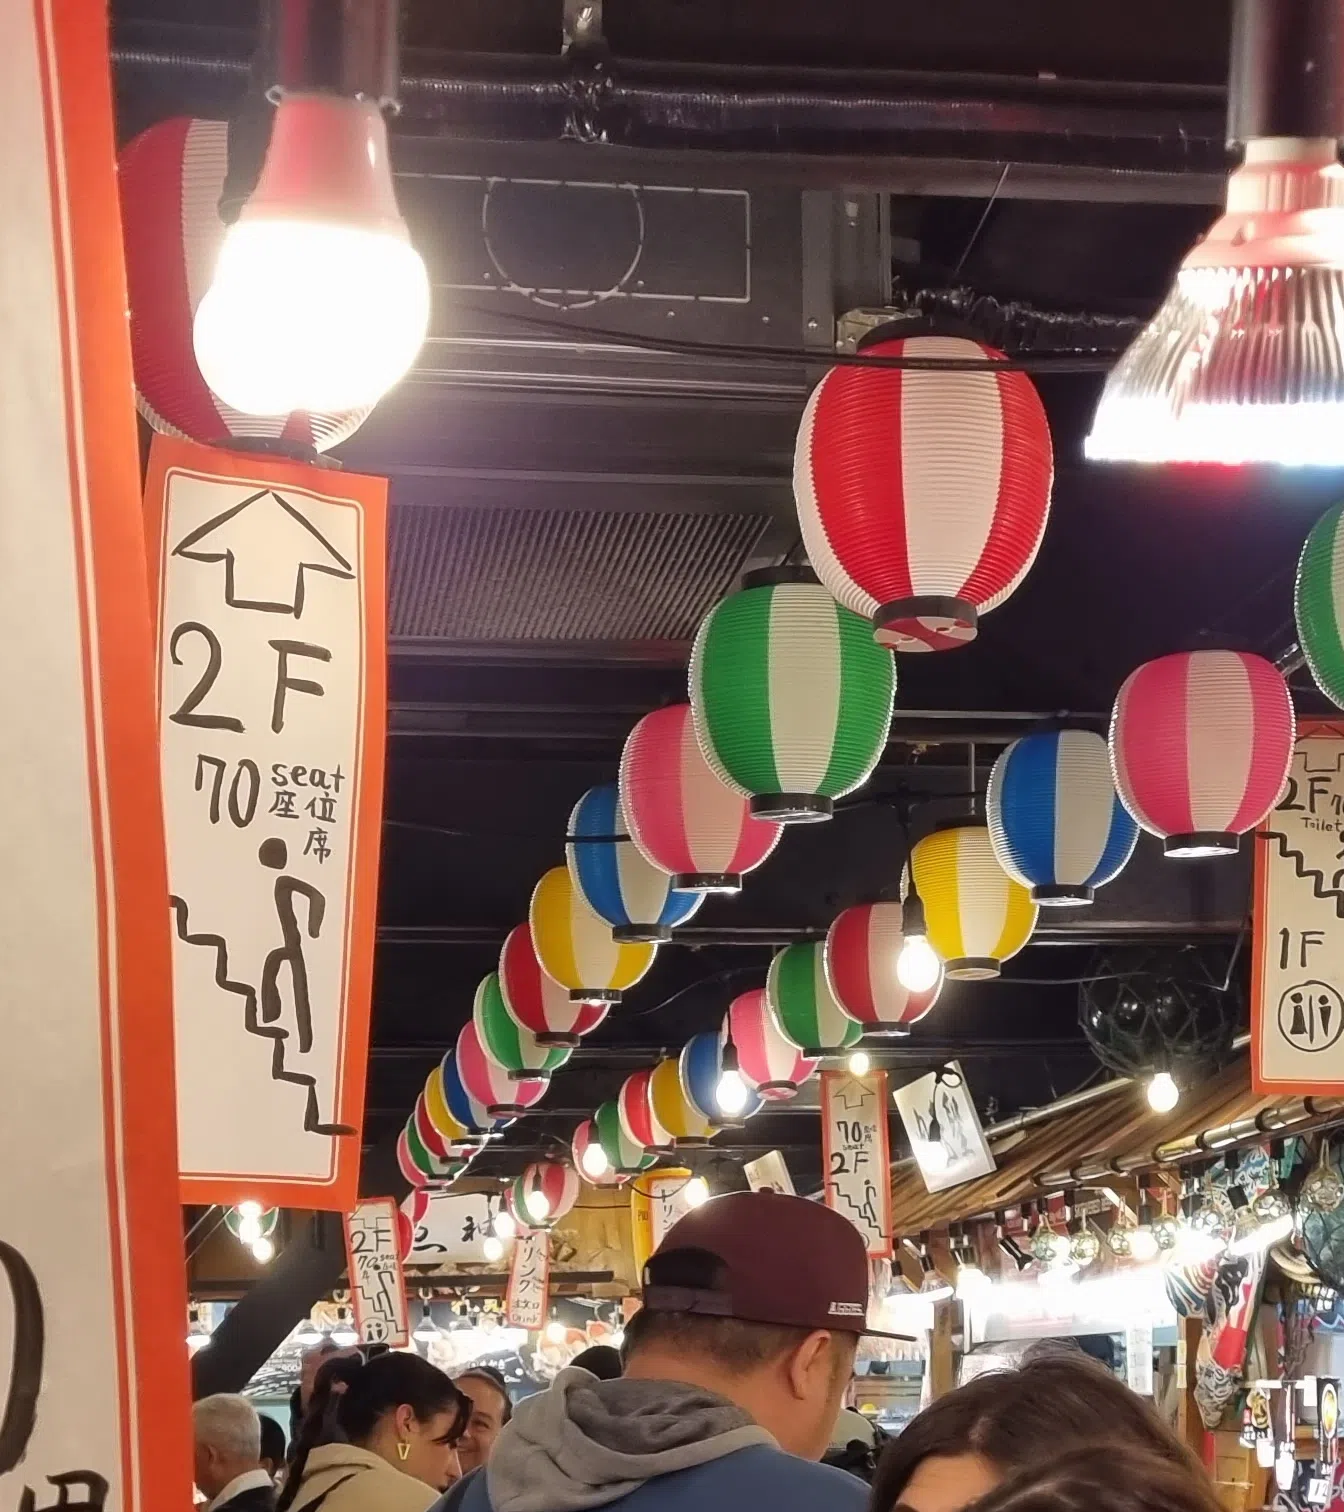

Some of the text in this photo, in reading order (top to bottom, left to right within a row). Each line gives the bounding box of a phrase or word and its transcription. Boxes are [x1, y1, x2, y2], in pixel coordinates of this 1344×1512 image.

[169, 621, 333, 734] 2F
[195, 754, 345, 828] 70 seat
[1275, 776, 1332, 814] 2F
[1300, 817, 1343, 833] Toilet
[1278, 927, 1326, 970] 1F
[837, 1121, 863, 1144] 70
[831, 1151, 869, 1175] 2F
[351, 1230, 391, 1254] 2F
